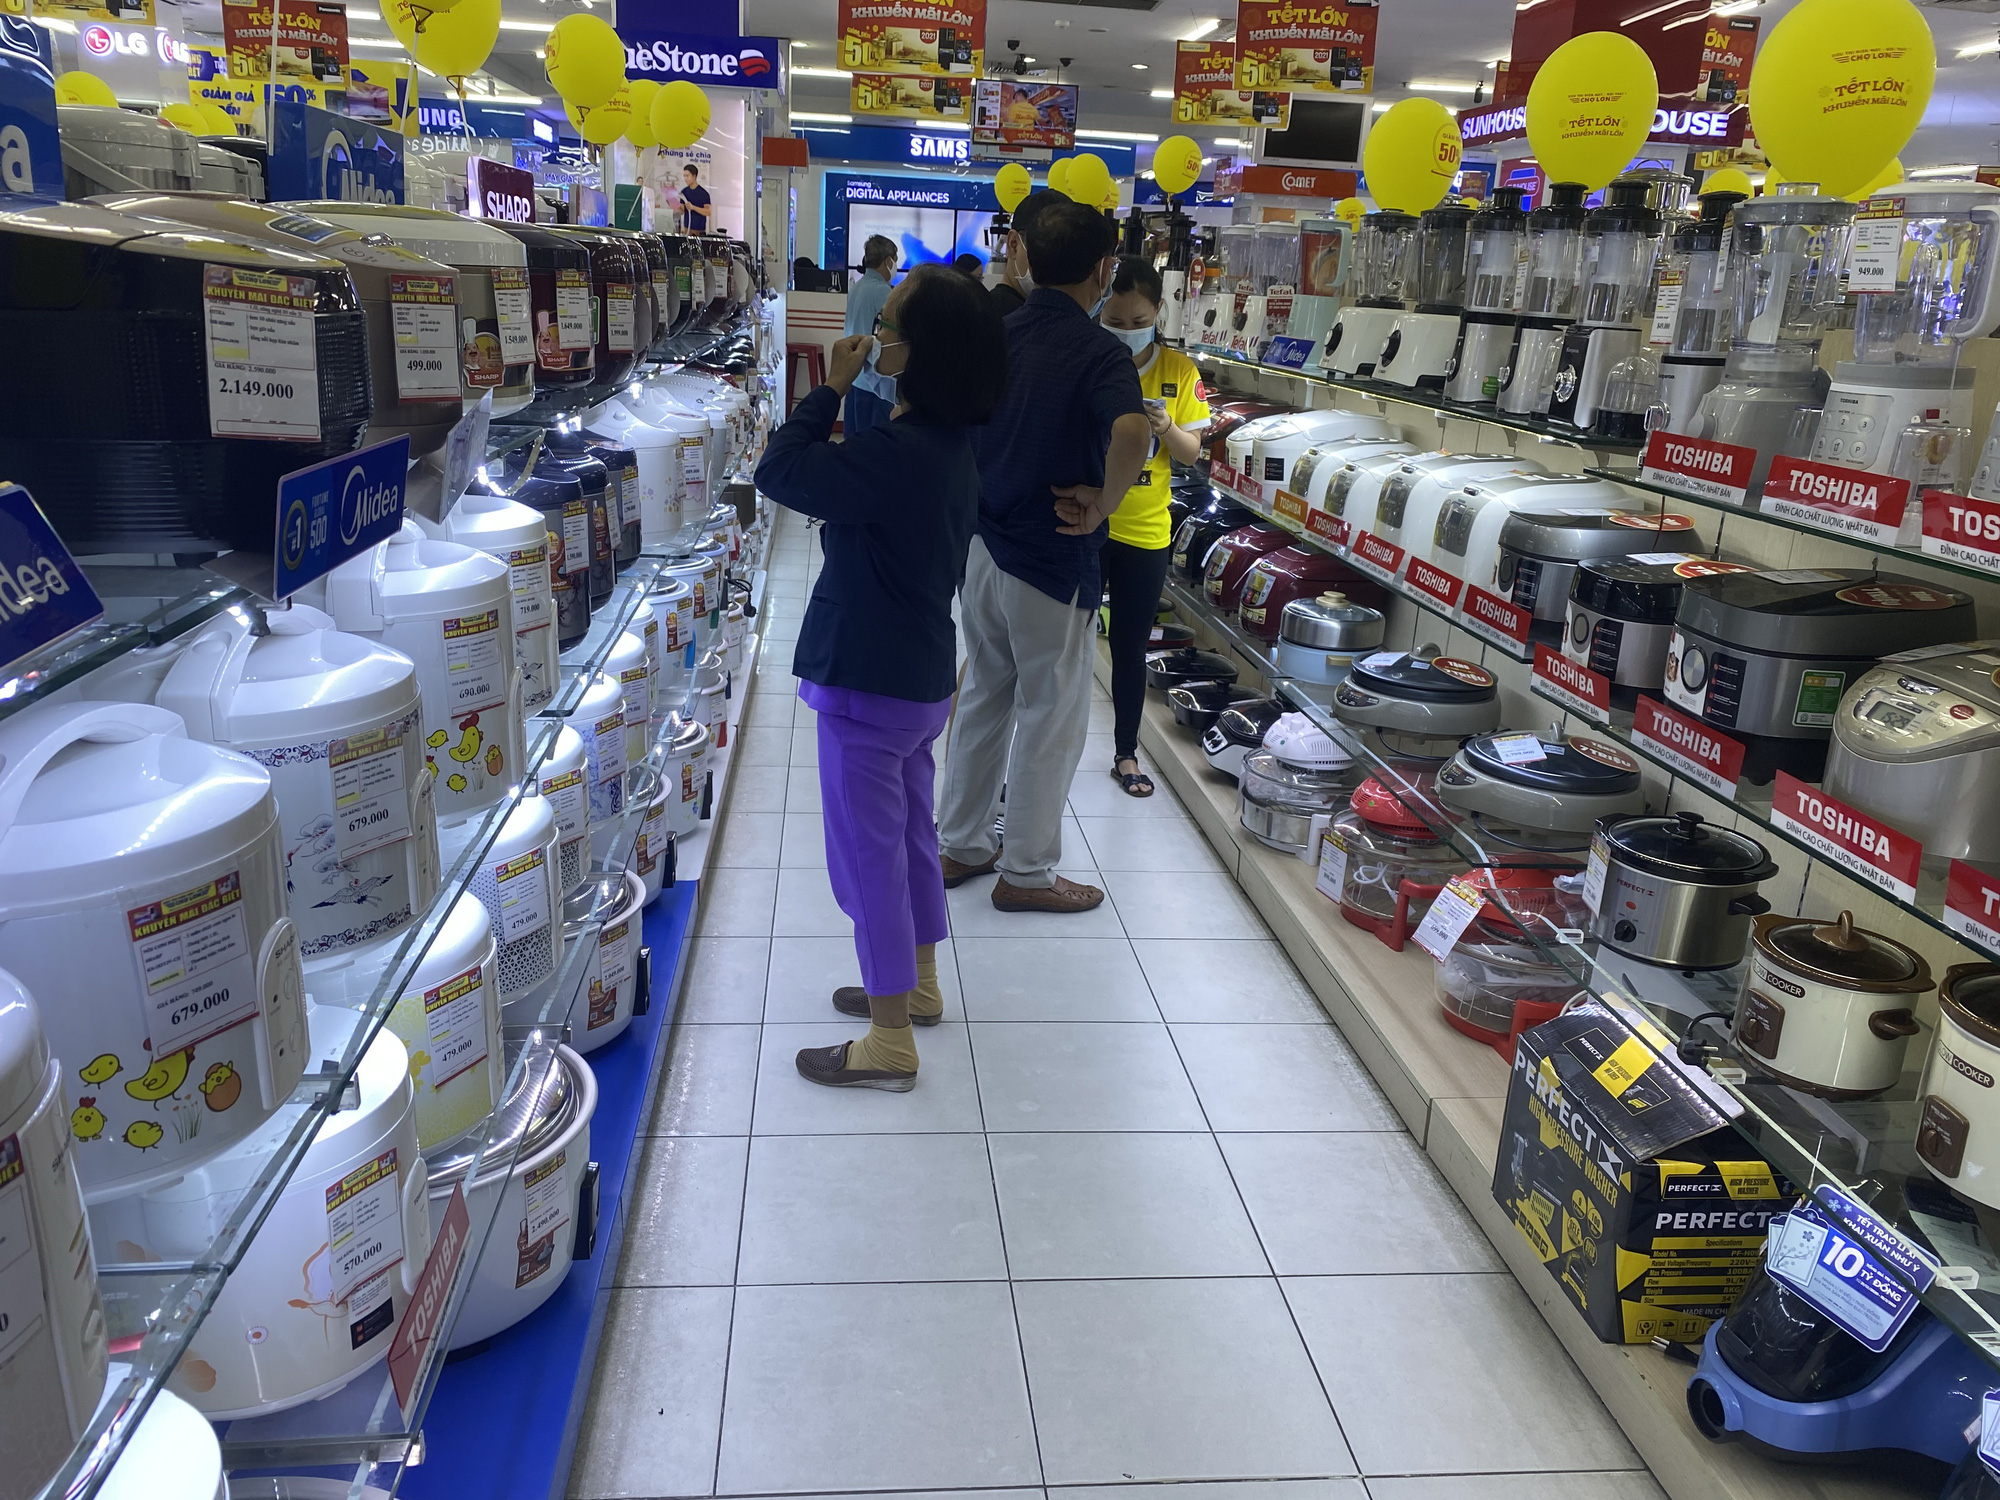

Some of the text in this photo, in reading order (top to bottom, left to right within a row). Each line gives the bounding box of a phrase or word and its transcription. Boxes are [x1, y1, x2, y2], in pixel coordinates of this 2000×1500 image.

[286, 11, 321, 30] LỚN
[852, 5, 973, 26] KHUYẾN MÃI LỚN
[1268, 1, 1349, 26] TẾT LỚN
[115, 32, 148, 55] LG
[314, 32, 337, 46] LỚN
[921, 32, 936, 40] 2021
[1249, 23, 1364, 44] KHUYẾN MÃI LỚN
[1200, 51, 1233, 70] TẾT
[1714, 50, 1743, 68] LỚN
[1835, 77, 1904, 97] TẾT LỚN
[1823, 95, 1908, 113] KHUYẾN MÃI LỚN
[1569, 114, 1620, 128] TẾT LỚN
[1562, 129, 1594, 139] KHUYẾN
[910, 138, 968, 159] SAMS
[486, 190, 531, 222] SHARP
[846, 187, 950, 204] DIGITAL APPLIANCES
[1858, 267, 1884, 276] 949.000
[207, 285, 245, 300] KHUYẾN
[1269, 288, 1293, 296] Tefal
[1201, 330, 1218, 345] Tefal
[1230, 335, 1248, 350] Tefal
[1282, 341, 1305, 363] Midea
[407, 360, 442, 371] 499.000
[219, 378, 293, 399] 2.149.000
[1664, 442, 1733, 476] TOSHIBA
[1653, 471, 1664, 481] ĐỈNH
[1664, 474, 1675, 483] CAO
[1789, 469, 1878, 510] TOSHIBA
[340, 465, 398, 545] Midea
[1280, 496, 1302, 516] TOSHIBA
[1314, 515, 1341, 538] TOSHIBA
[1775, 502, 1879, 537] ĐỈNH CAO CHẤT LƯỢNG NHẬT BẢN
[1949, 506, 2000, 541] TOS
[310, 515, 327, 549] 500
[1362, 538, 1394, 565] TOSHIBA
[1940, 543, 2000, 568] ĐỈNH CAO CHẤT
[1416, 565, 1451, 597] TOSHIBA
[520, 603, 540, 614] 719.000
[1476, 595, 1517, 632] TOSHIBA
[1546, 655, 1595, 697] TOSHIBA
[459, 683, 490, 699] 690.000
[1652, 710, 1721, 765] TOSHIBA
[1642, 737, 1654, 750] ĐỈNH
[1654, 743, 1665, 755] CAO
[1665, 749, 1678, 763] CHẤT
[1711, 775, 1722, 789] BẢN
[349, 808, 389, 832] 679.000
[1797, 790, 1891, 863] TOSHIBA
[1785, 819, 1895, 891] ĐỈNH CAO CHẤT LƯỢNG NHẬT BẢN
[1617, 878, 1645, 894] PERFECT
[134, 916, 177, 938] KHUYẾN
[512, 912, 537, 929] 479.000
[1965, 922, 1988, 942] ĐỈNH
[604, 965, 625, 982] 2.049.000
[1767, 974, 1802, 996] COOKER
[171, 988, 230, 1025] 679.000
[442, 1039, 472, 1061] 479.000
[1953, 1058, 1991, 1086] COOKER
[1515, 1048, 1597, 1152] PERFECT
[1528, 1093, 1584, 1170] HIGH PRESSURE
[1584, 1155, 1618, 1209] WASHER
[1737, 1187, 1759, 1195] WASHER
[1743, 1178, 1770, 1186] PRESSURE
[531, 1208, 560, 1233] 2.490.000
[1654, 1212, 1772, 1230] PERFECT
[1856, 1214, 1897, 1245] TẾT TRAO
[1706, 1239, 1743, 1247] Specifications
[1843, 1217, 1920, 1272] KHAI XUÂN NHƯ Ý
[344, 1241, 382, 1275] 570.000
[1823, 1235, 1865, 1278] 10
[406, 1226, 458, 1356] TOSHIBA
[1860, 1270, 1873, 1281] TỶ
[1873, 1279, 1902, 1302] ĐỒNG
